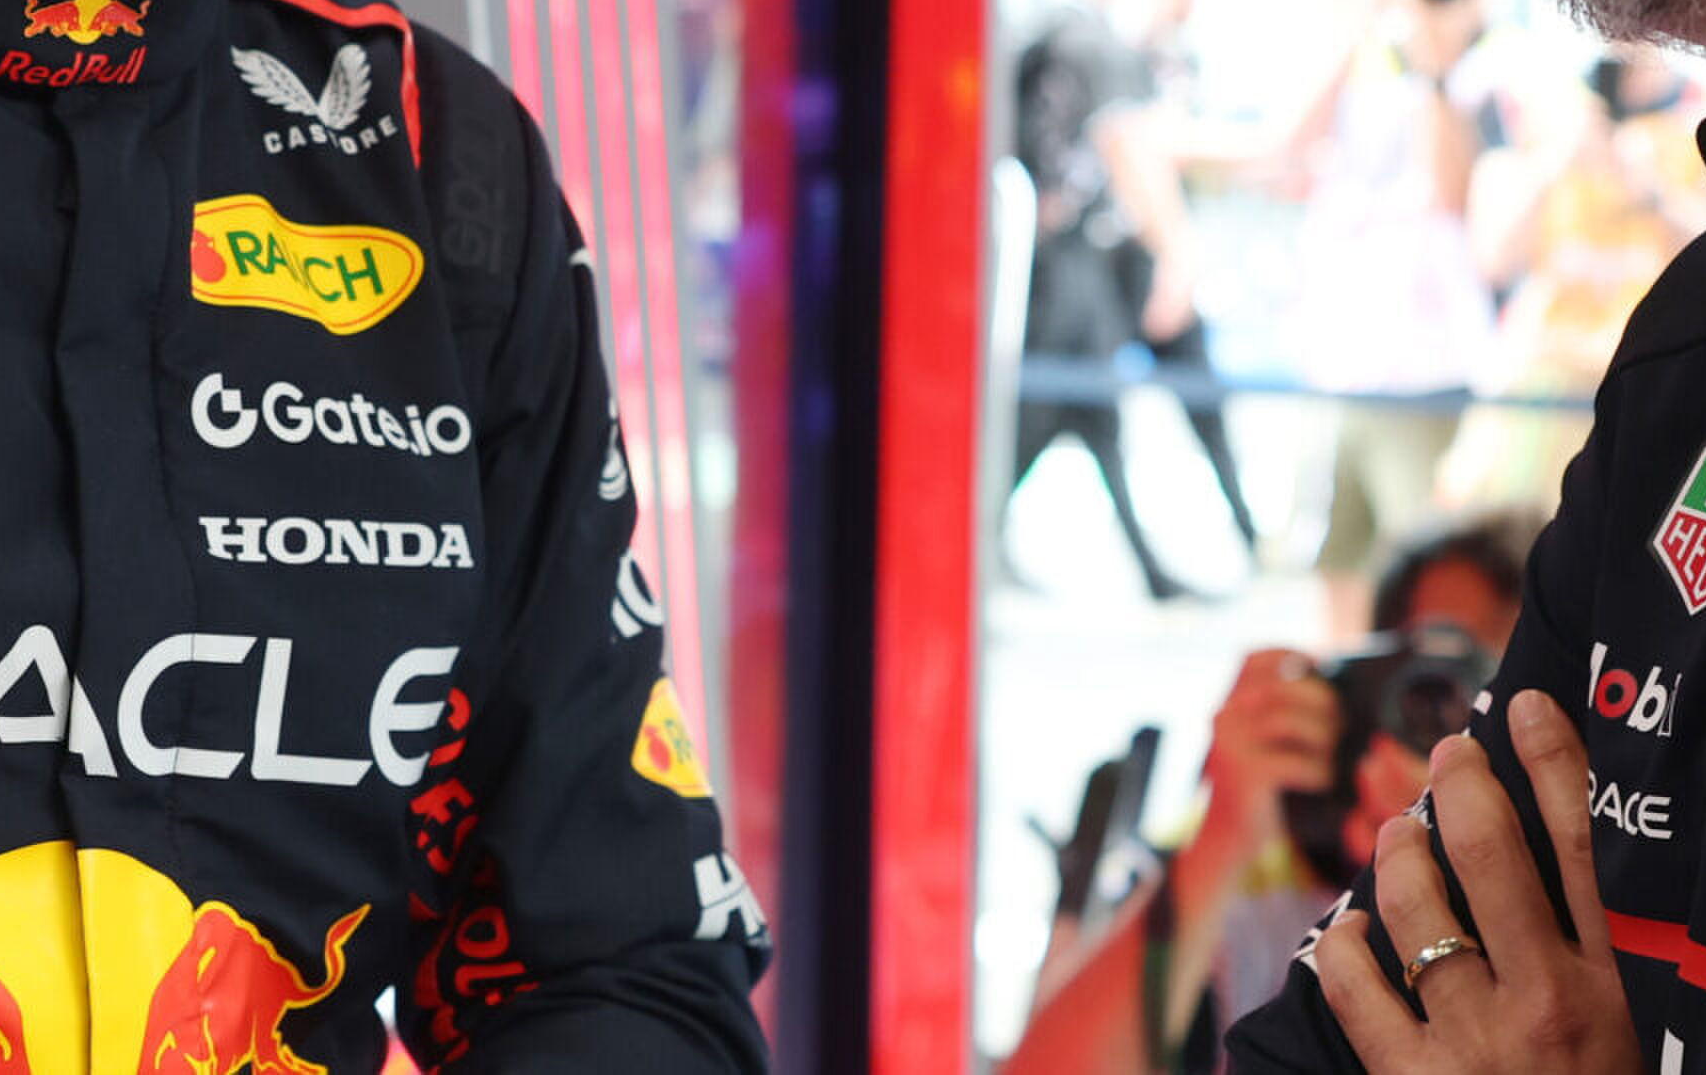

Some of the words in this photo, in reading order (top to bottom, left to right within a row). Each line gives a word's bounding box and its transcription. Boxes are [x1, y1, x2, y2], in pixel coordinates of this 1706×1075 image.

[226, 230, 385, 303] RACH
[262, 381, 472, 457] Gate.io
[198, 515, 475, 569] HONDA
